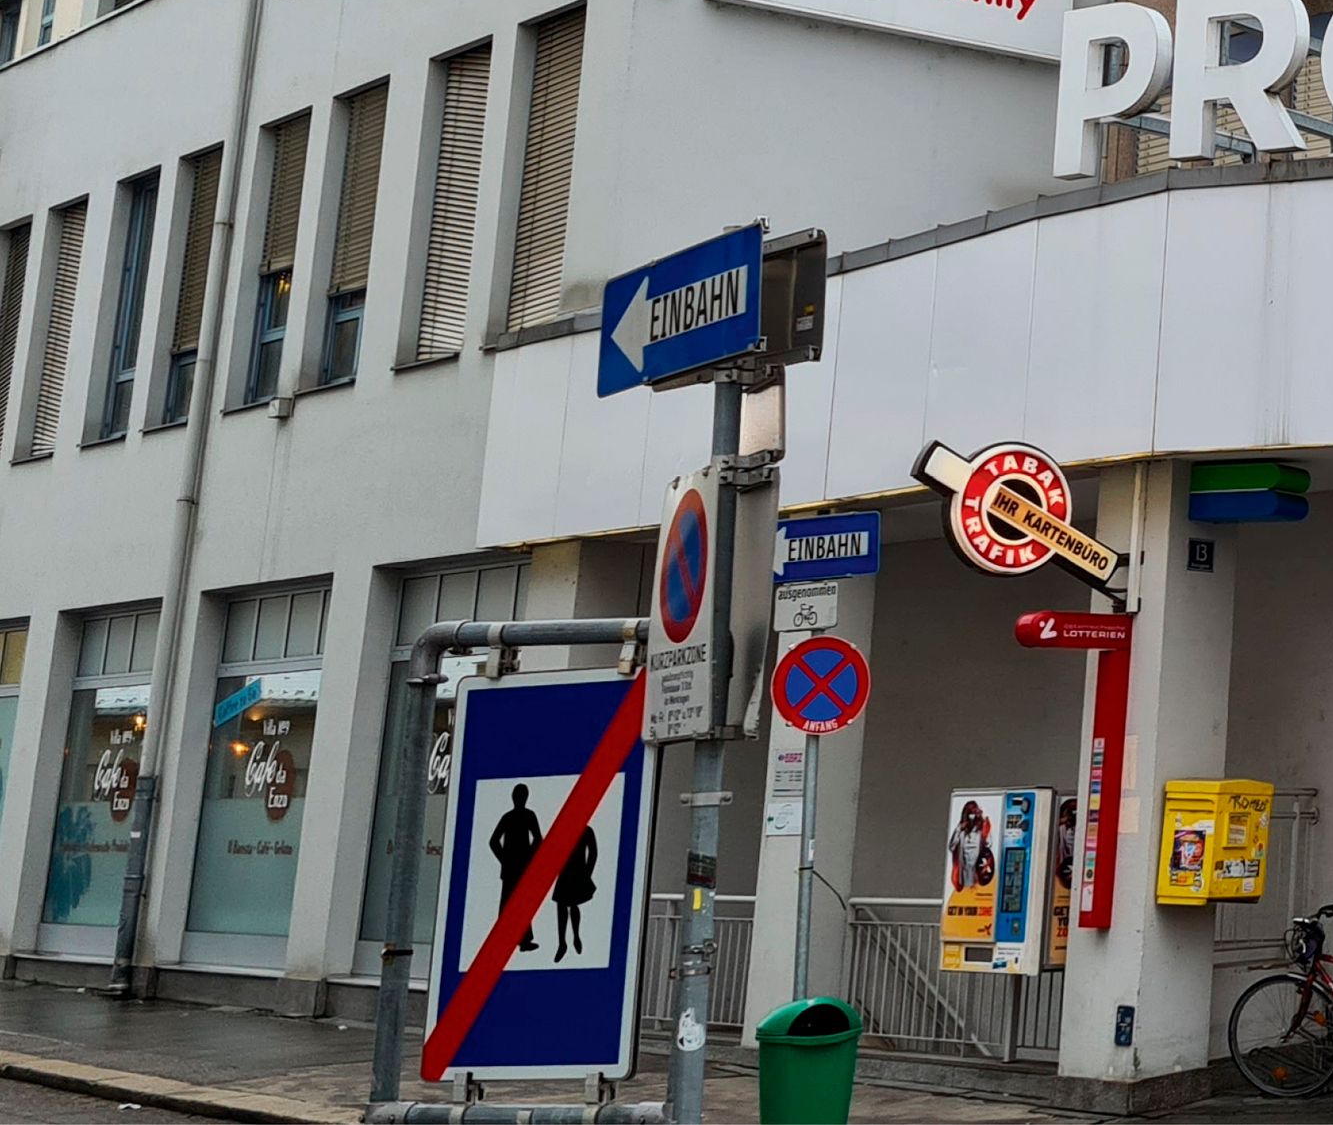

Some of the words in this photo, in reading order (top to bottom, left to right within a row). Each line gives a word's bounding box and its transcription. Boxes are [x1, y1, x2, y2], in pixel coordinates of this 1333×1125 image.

[650, 269, 740, 342] EINBAHN
[984, 454, 1064, 506] TABAK
[787, 532, 861, 562] EINBAHN
[964, 496, 1037, 565] TRAFIK
[993, 492, 1019, 517] IHR
[1022, 510, 1109, 571] KARTENBÜRO
[778, 584, 836, 602] ausgenommen
[1063, 630, 1126, 639] LOTTERIEN
[803, 719, 838, 733] ANFANG
[244, 741, 280, 797] Cafe
